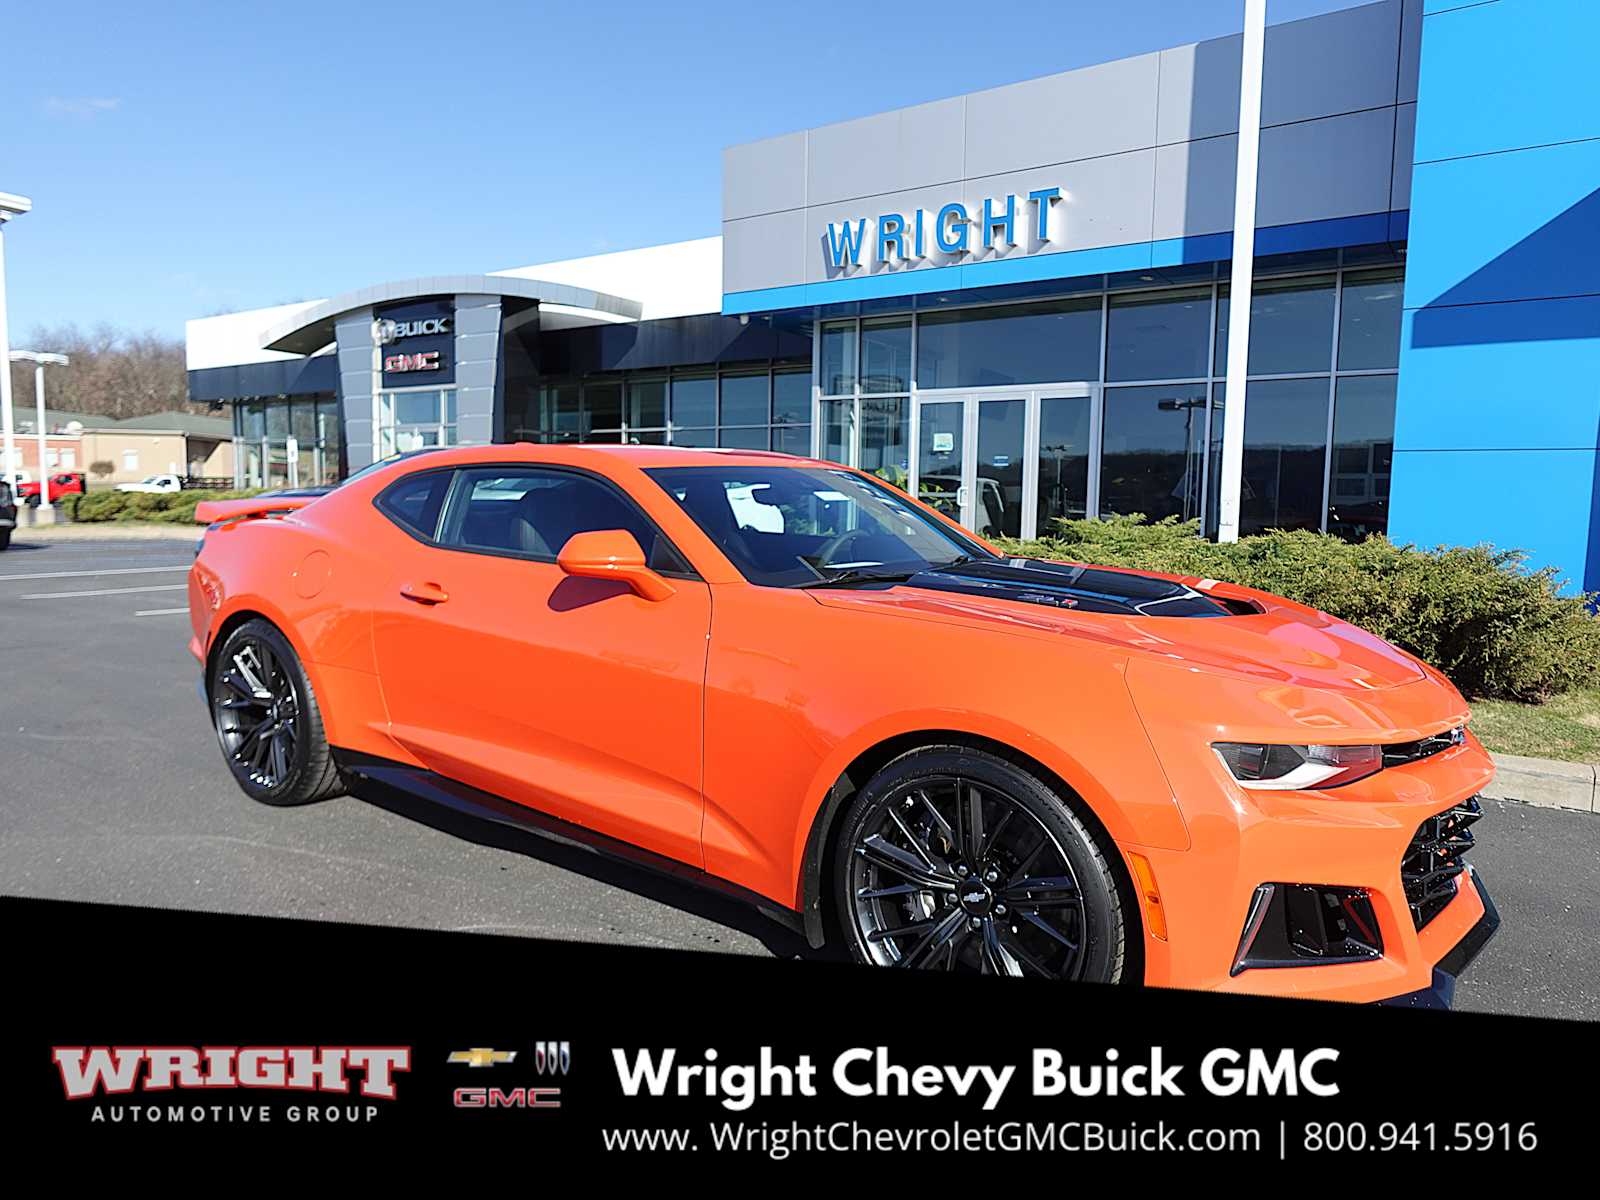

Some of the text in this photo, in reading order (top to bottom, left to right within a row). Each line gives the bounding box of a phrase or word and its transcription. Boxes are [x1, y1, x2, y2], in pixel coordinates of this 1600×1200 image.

[827, 187, 1062, 268] WRIGHT
[394, 319, 449, 338] BUICK
[385, 352, 439, 373] GMC
